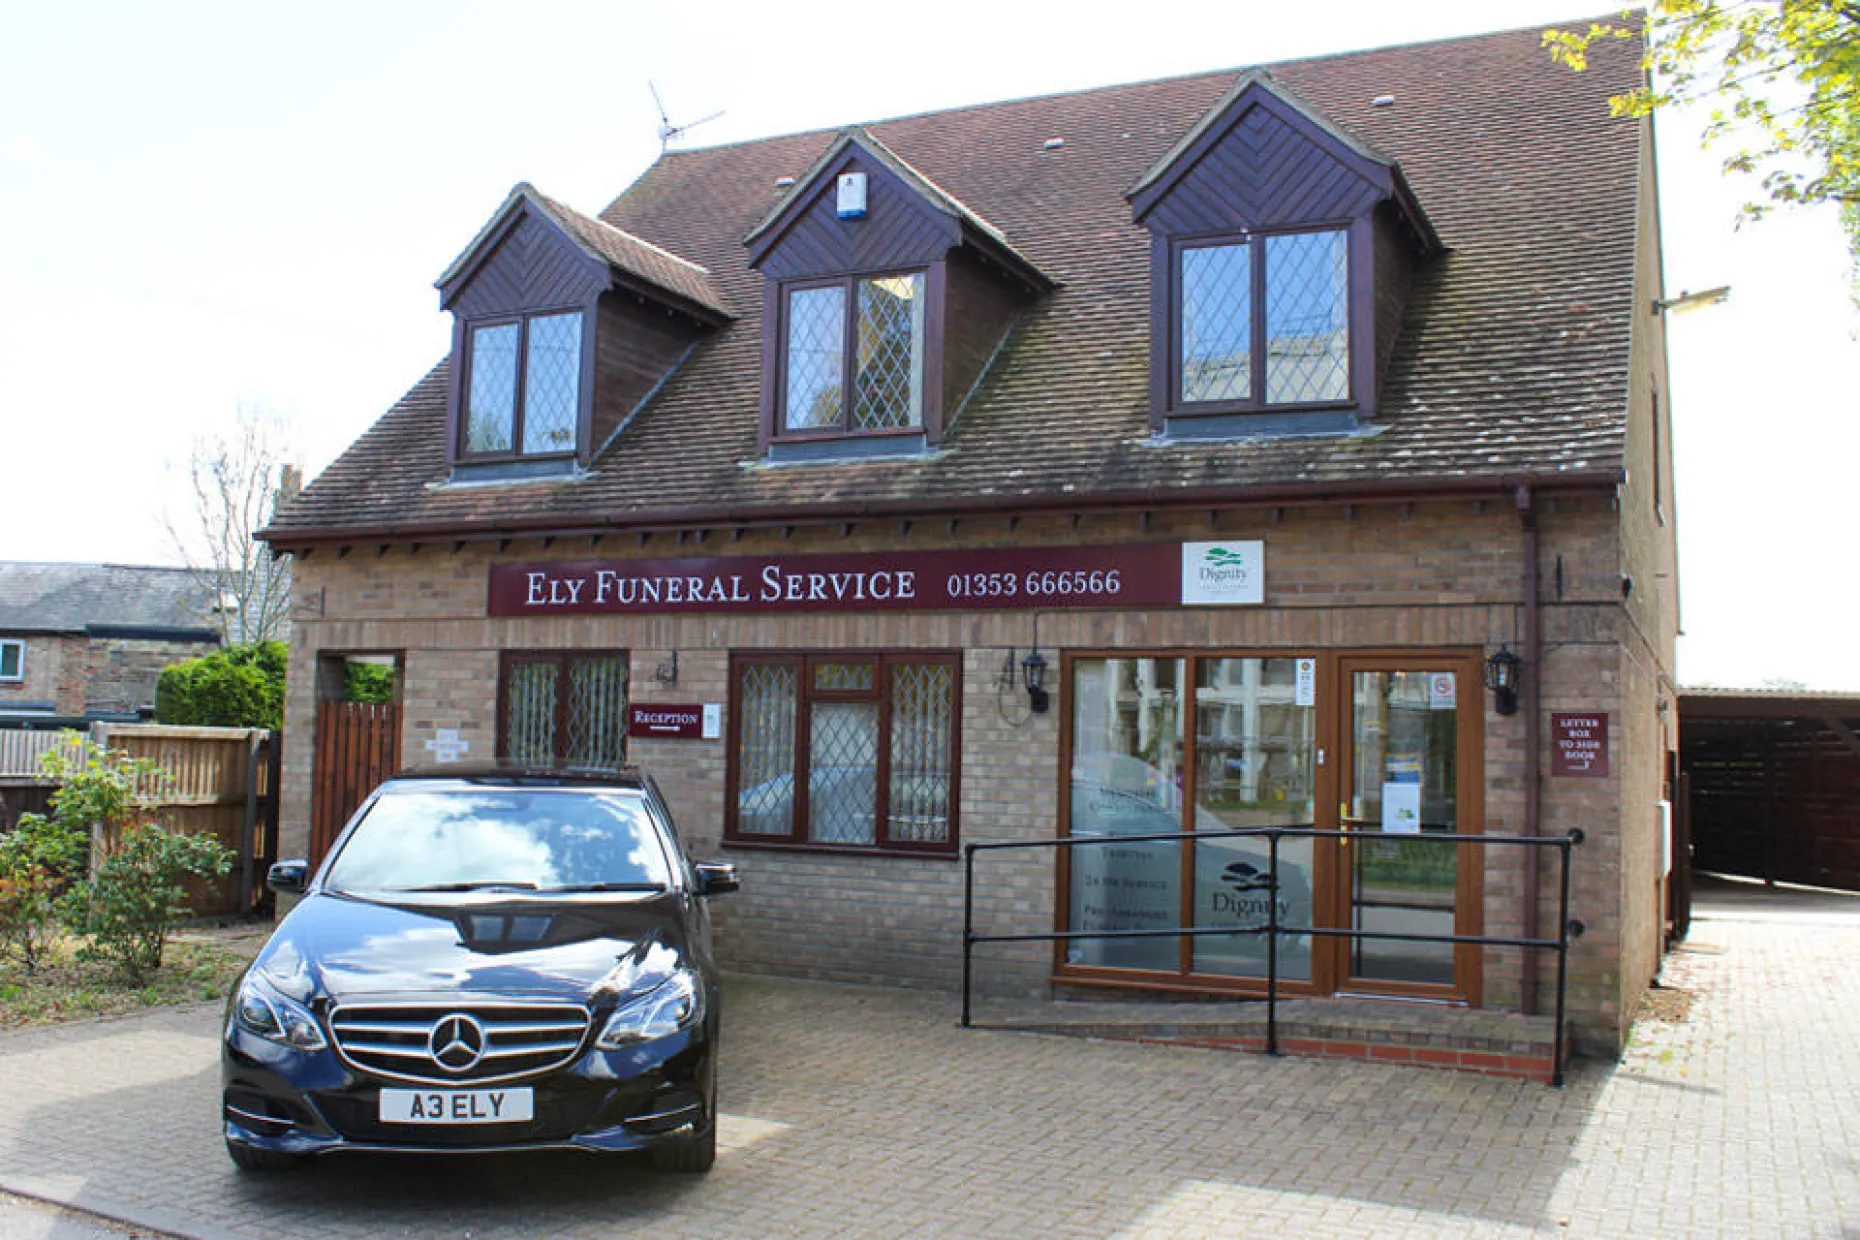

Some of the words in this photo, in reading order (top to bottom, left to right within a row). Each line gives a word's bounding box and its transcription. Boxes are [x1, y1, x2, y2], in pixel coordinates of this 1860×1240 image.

[526, 573, 585, 605] ELY
[596, 571, 750, 604] FUNERAL
[760, 565, 916, 601] SERVICE
[947, 573, 1017, 597] 01353
[1025, 570, 1121, 595] 666566
[1199, 567, 1247, 583] Dignity
[635, 710, 698, 724] RECEPTION
[411, 1094, 443, 1118] A3
[452, 1093, 504, 1118] ELY
